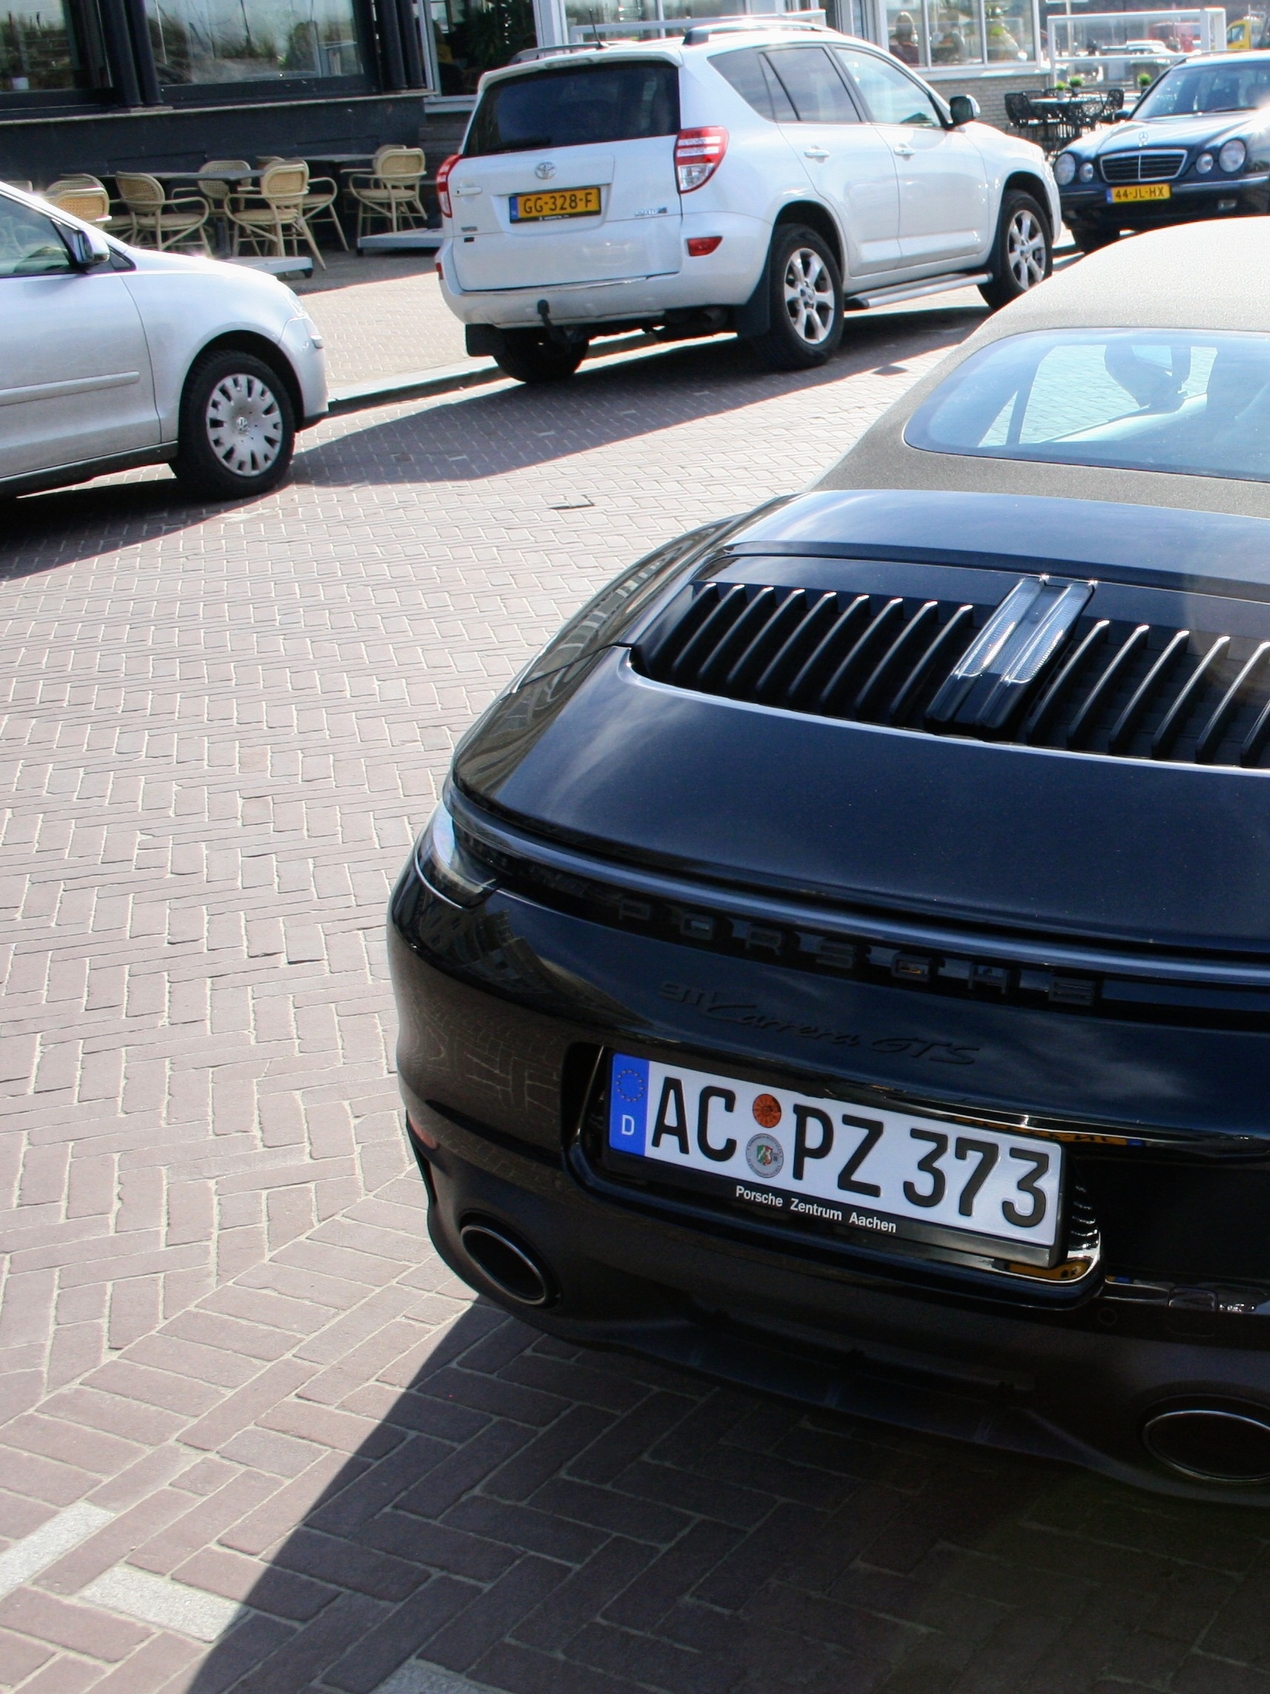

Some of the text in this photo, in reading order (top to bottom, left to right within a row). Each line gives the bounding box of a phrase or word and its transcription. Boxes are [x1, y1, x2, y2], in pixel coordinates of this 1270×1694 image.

[523, 191, 593, 214] GG-328-F
[617, 900, 1096, 1007] PORSCHE
[700, 1003, 860, 1047] Carrera
[861, 1036, 980, 1065] GTS
[621, 1114, 635, 1136] D
[651, 1076, 737, 1162] AC
[792, 1103, 884, 1198] PZ
[903, 1128, 1049, 1228] 373
[735, 1185, 897, 1233] Porsche Zentrum Aachen
